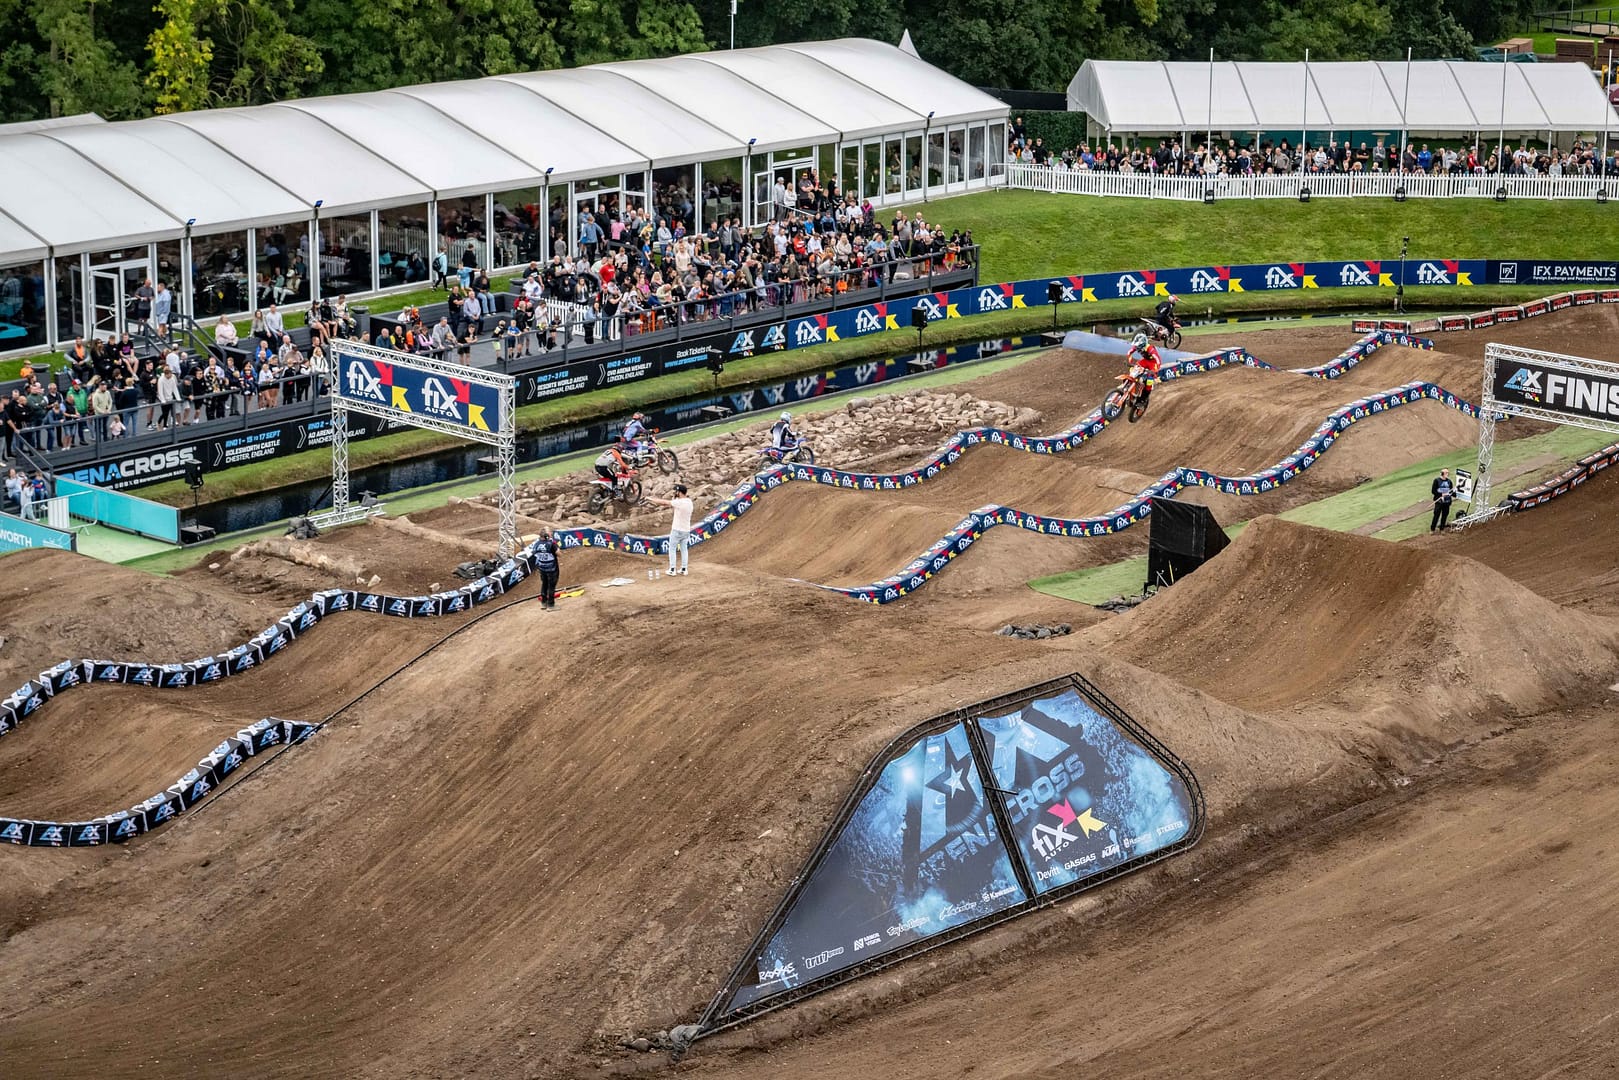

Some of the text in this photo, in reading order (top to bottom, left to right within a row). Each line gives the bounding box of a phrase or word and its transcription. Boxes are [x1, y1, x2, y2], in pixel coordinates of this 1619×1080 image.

[1533, 266, 1616, 277] IFX PAYMENTS
[676, 349, 689, 358] Book
[689, 347, 705, 355] Tickets
[347, 360, 386, 401] fix
[350, 390, 376, 399] AUTO
[422, 377, 462, 420] fix
[424, 406, 452, 417] AUTO
[266, 430, 280, 439] SEPT
[226, 440, 280, 456] BOLESWORTH CASTLE
[226, 448, 274, 463] CHESTER, ENGLAND
[62, 446, 194, 484] ENACROSS
[1032, 822, 1079, 857] fix
[1045, 841, 1069, 862] AUTO
[1037, 866, 1061, 881] Devitt
[1064, 853, 1096, 870] GASGAS
[1102, 844, 1120, 858] KTM
